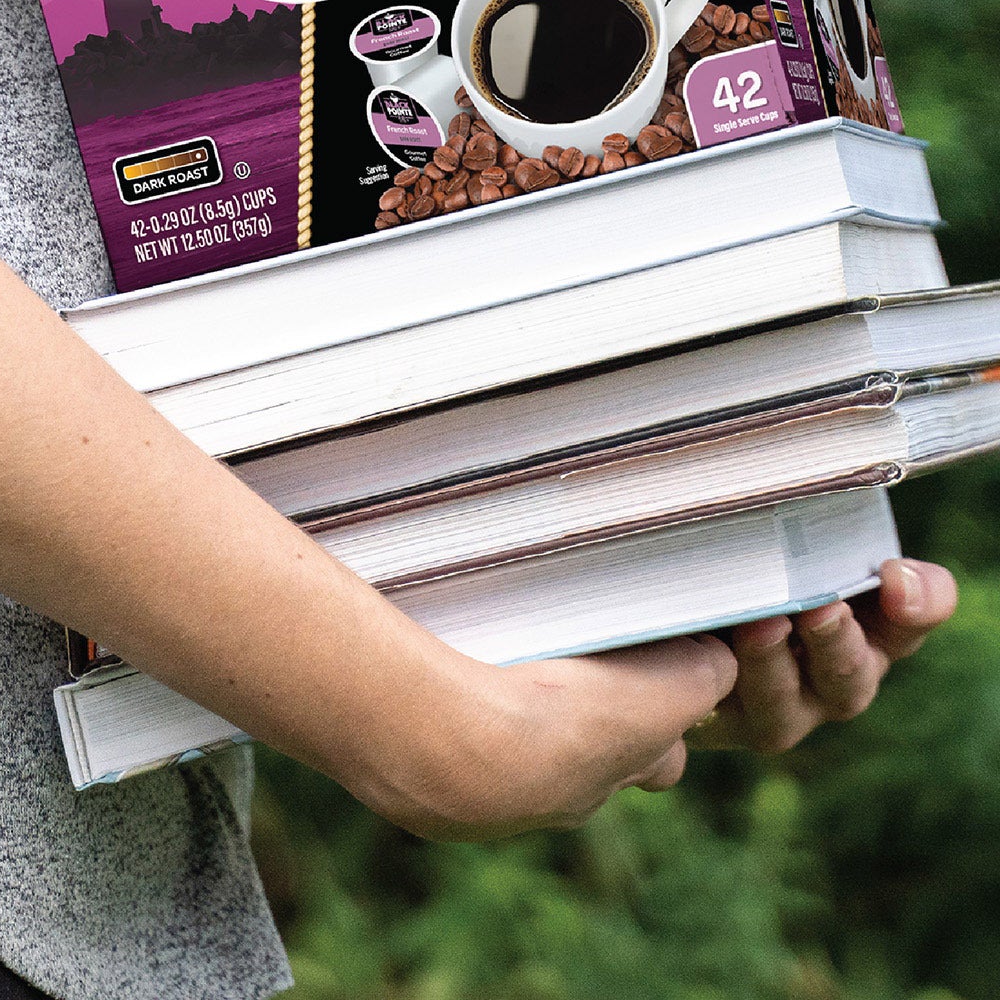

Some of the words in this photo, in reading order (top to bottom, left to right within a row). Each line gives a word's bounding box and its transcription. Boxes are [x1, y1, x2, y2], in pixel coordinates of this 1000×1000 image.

[712, 70, 768, 115] 42
[713, 118, 737, 134] Single
[738, 115, 760, 128] Serve
[761, 109, 779, 124] Cups
[133, 177, 167, 194] DARK
[168, 166, 209, 186] ROAST
[366, 164, 388, 175] Serving
[130, 211, 180, 238] 42-0.29
[181, 206, 199, 226] OZ
[199, 195, 241, 224] (8.5g)
[242, 187, 277, 211] CUPS
[134, 241, 158, 263] NET
[158, 236, 179, 257] WT
[180, 228, 213, 252] 12.50
[213, 223, 231, 244] OZ
[232, 212, 272, 242] (357g)
